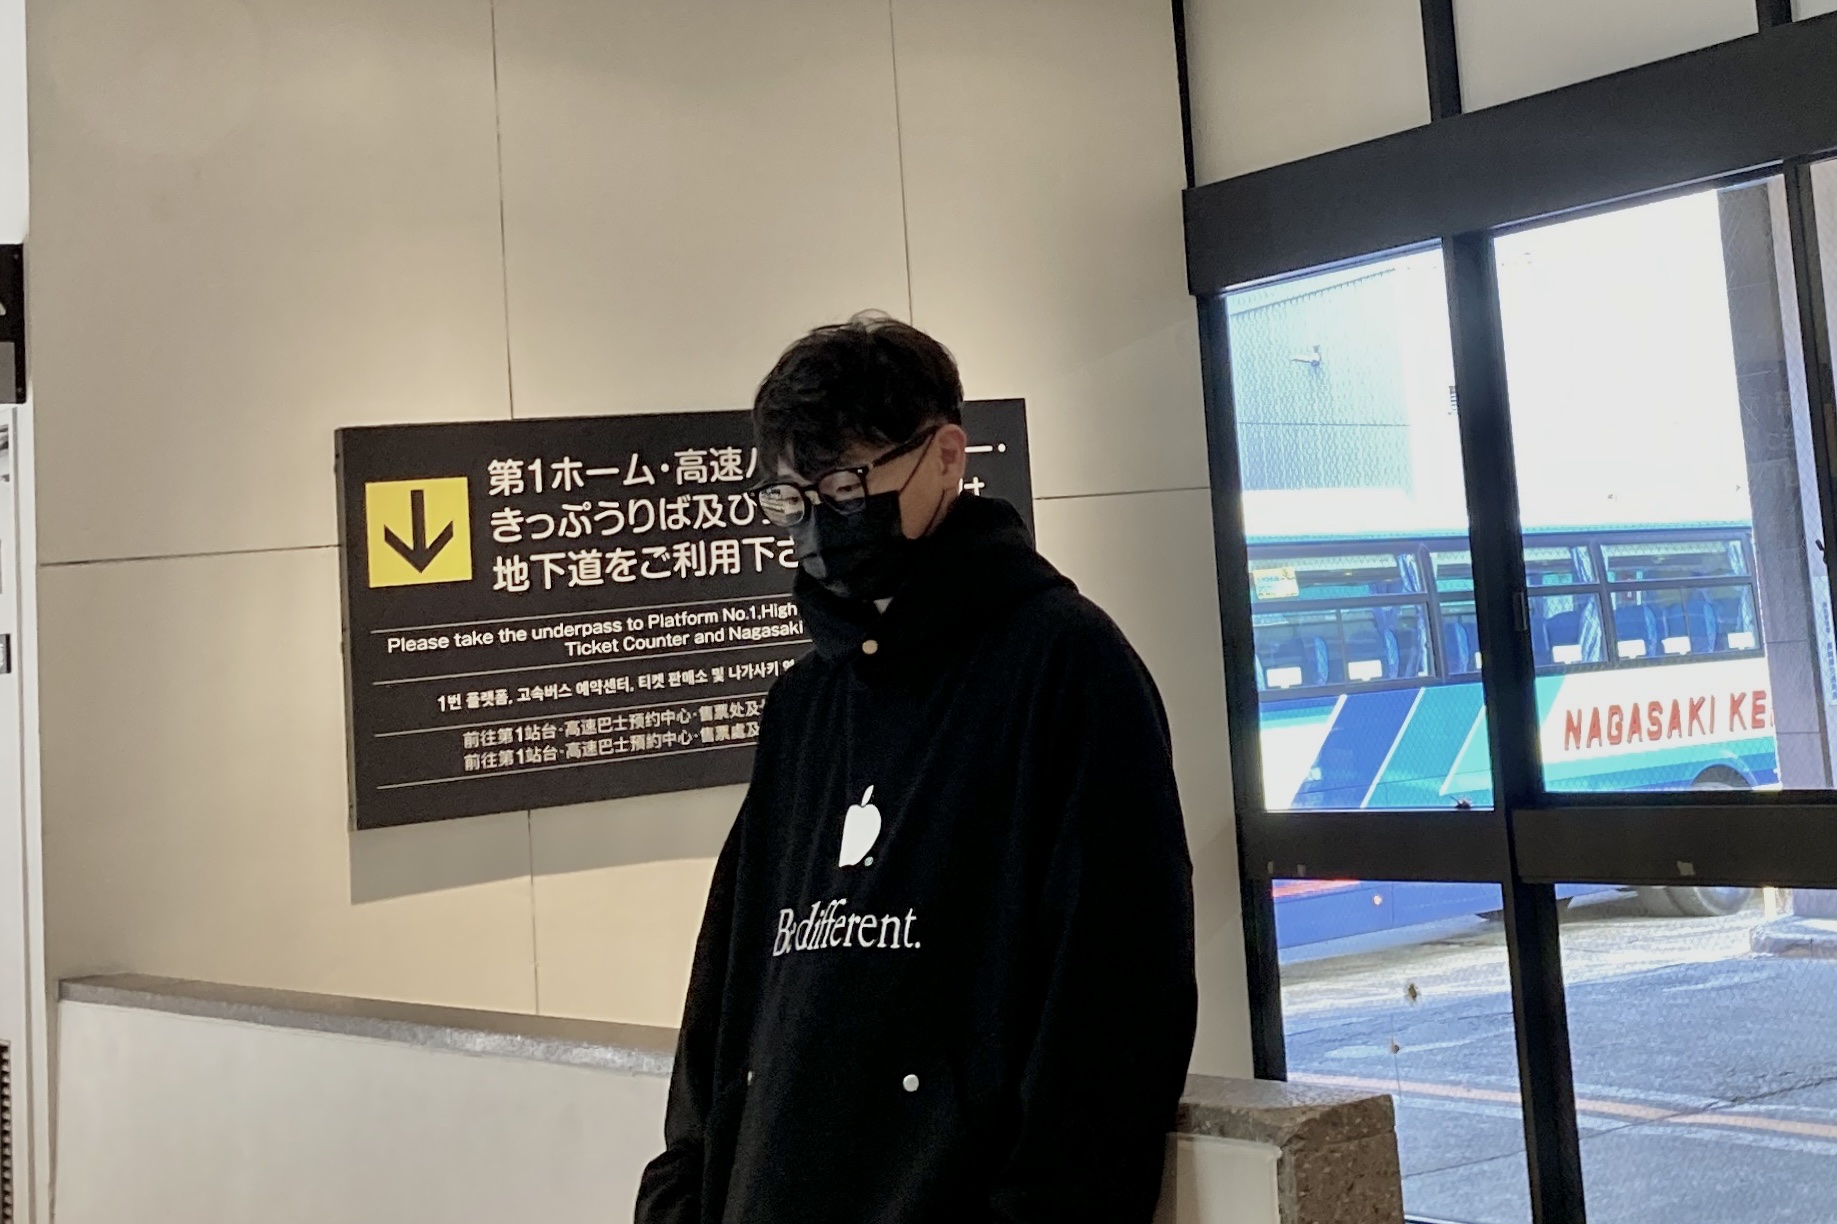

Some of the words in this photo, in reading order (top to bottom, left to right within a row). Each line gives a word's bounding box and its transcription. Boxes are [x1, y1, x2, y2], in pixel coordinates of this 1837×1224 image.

[490, 492, 771, 543] きっぷうりば及び
[387, 636, 450, 654] Please
[453, 630, 494, 648] take
[498, 627, 528, 643] the
[531, 619, 623, 641] underpass
[626, 617, 644, 632] to
[647, 610, 719, 630] Platform
[564, 638, 620, 657] Ticket
[623, 632, 690, 652] Counter
[694, 627, 725, 645] and
[728, 620, 804, 642] Nagasaki
[437, 693, 462, 713] 1번
[517, 683, 573, 702] 고속버스
[638, 672, 665, 690] 티켓
[668, 668, 709, 688] 판매소
[728, 660, 779, 681] 나가사키
[1564, 694, 1716, 752] NAGASAKI
[1729, 689, 1775, 732] KE
